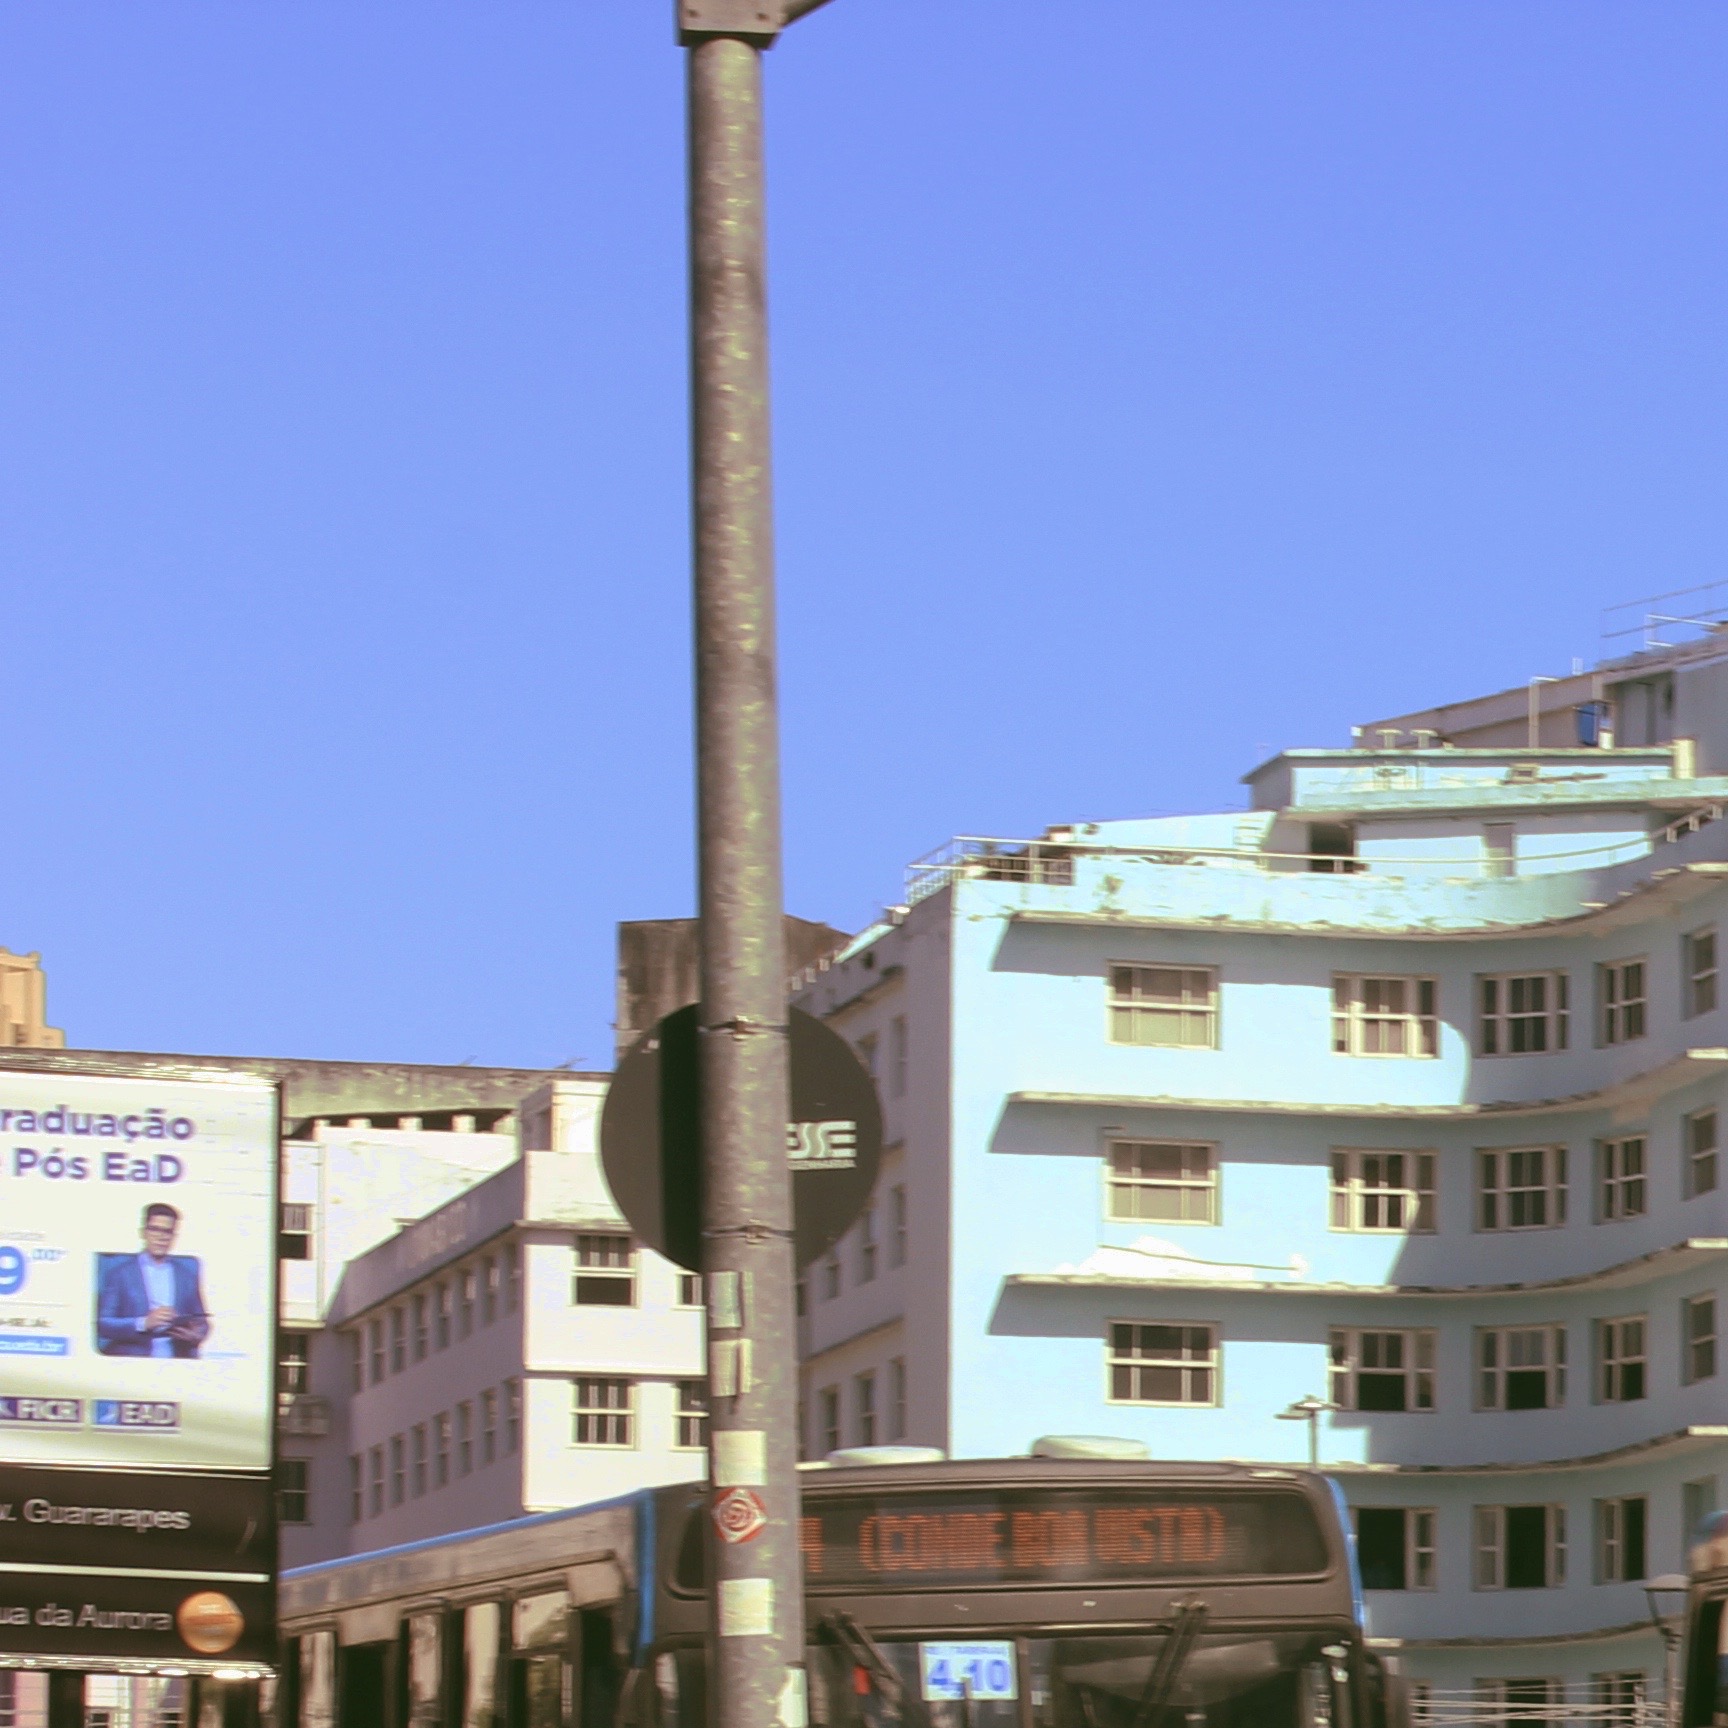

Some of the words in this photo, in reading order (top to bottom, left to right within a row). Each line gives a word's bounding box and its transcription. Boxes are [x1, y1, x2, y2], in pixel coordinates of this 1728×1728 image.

[0, 1104, 194, 1142] raduação
[14, 1147, 87, 1180] Pós
[101, 1151, 183, 1184] EaD
[120, 1403, 177, 1426] EAD
[0, 1503, 17, 1522] v.
[23, 1498, 191, 1533] Guararapes
[0, 1606, 30, 1626] ua
[35, 1603, 74, 1627] da
[77, 1604, 173, 1631] Aurora
